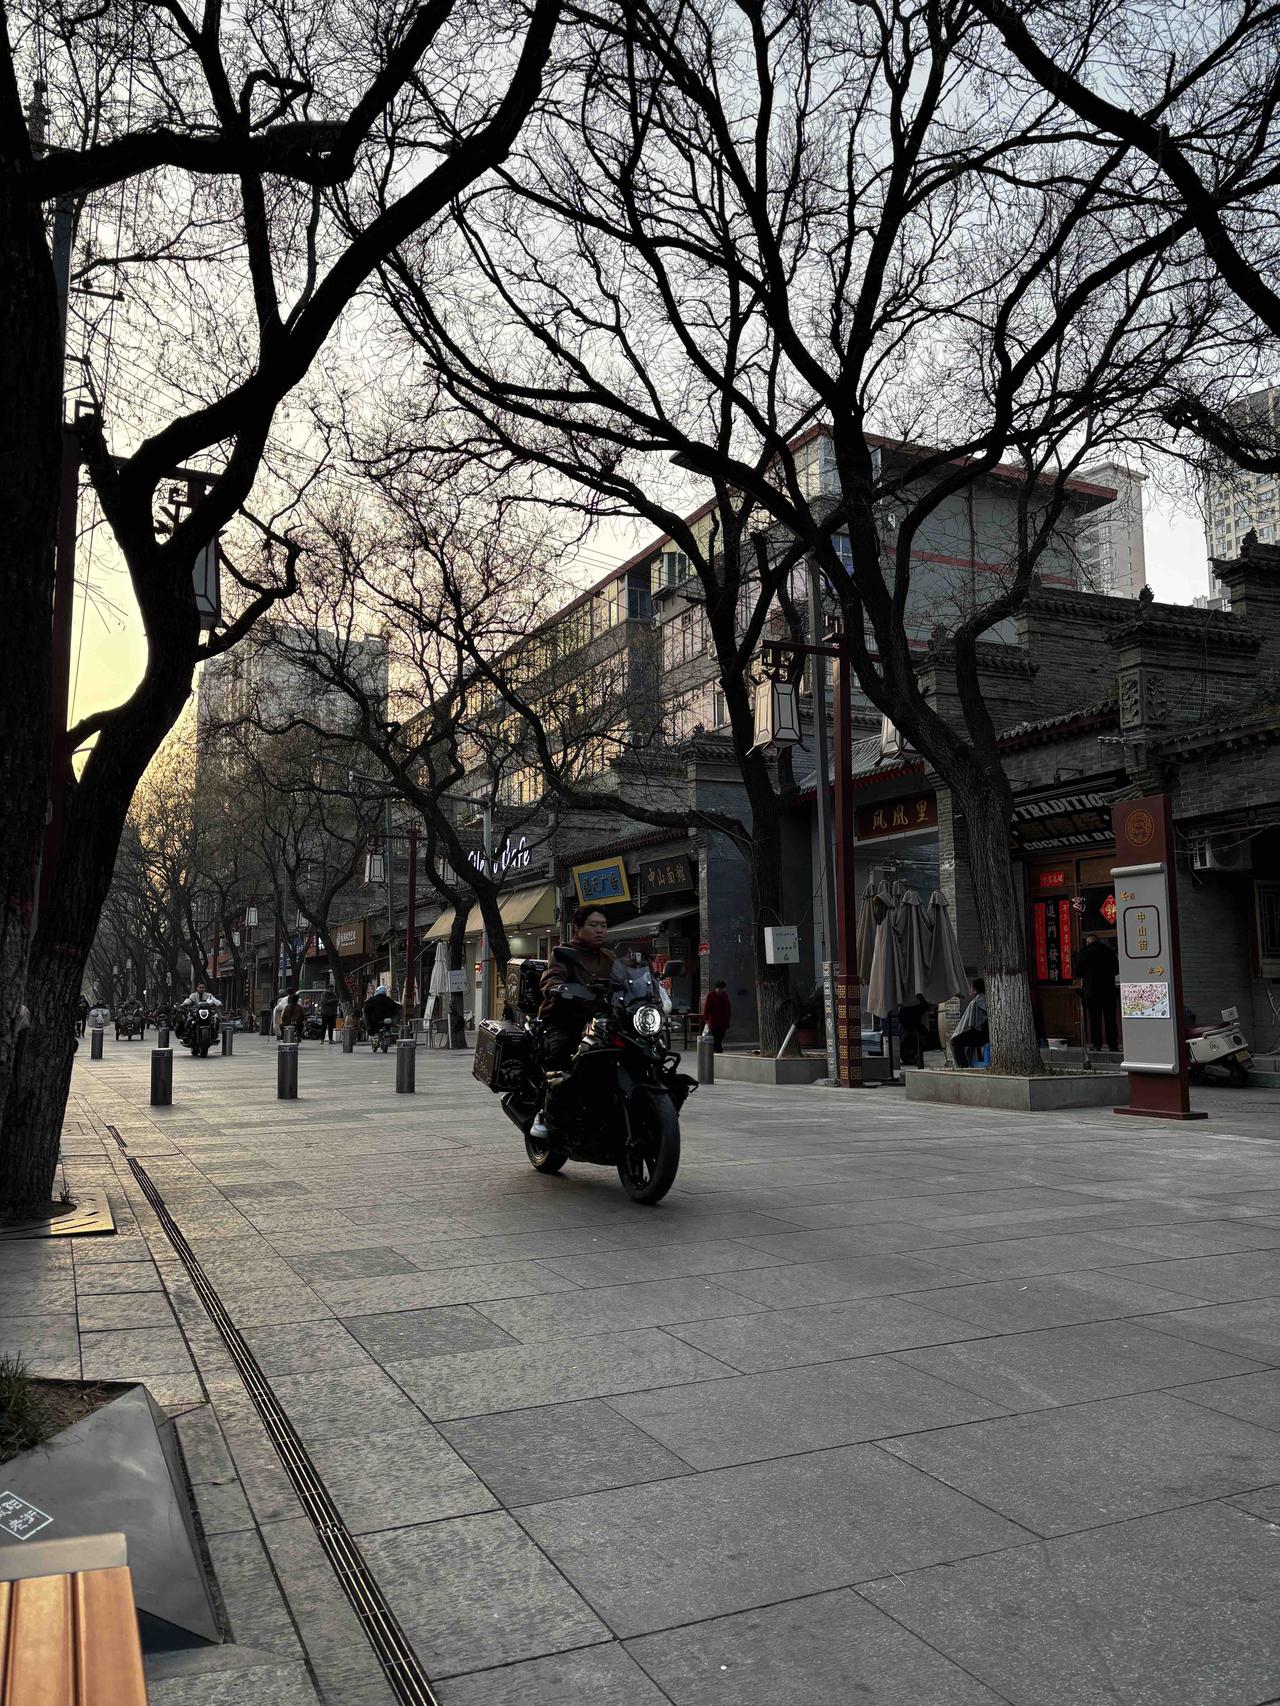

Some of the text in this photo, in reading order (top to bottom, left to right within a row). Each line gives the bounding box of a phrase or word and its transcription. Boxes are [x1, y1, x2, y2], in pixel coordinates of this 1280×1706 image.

[872, 800, 928, 830] 凤凰里
[1023, 834, 1092, 851] COCKTAIL
[1137, 911, 1148, 951] 中山街
